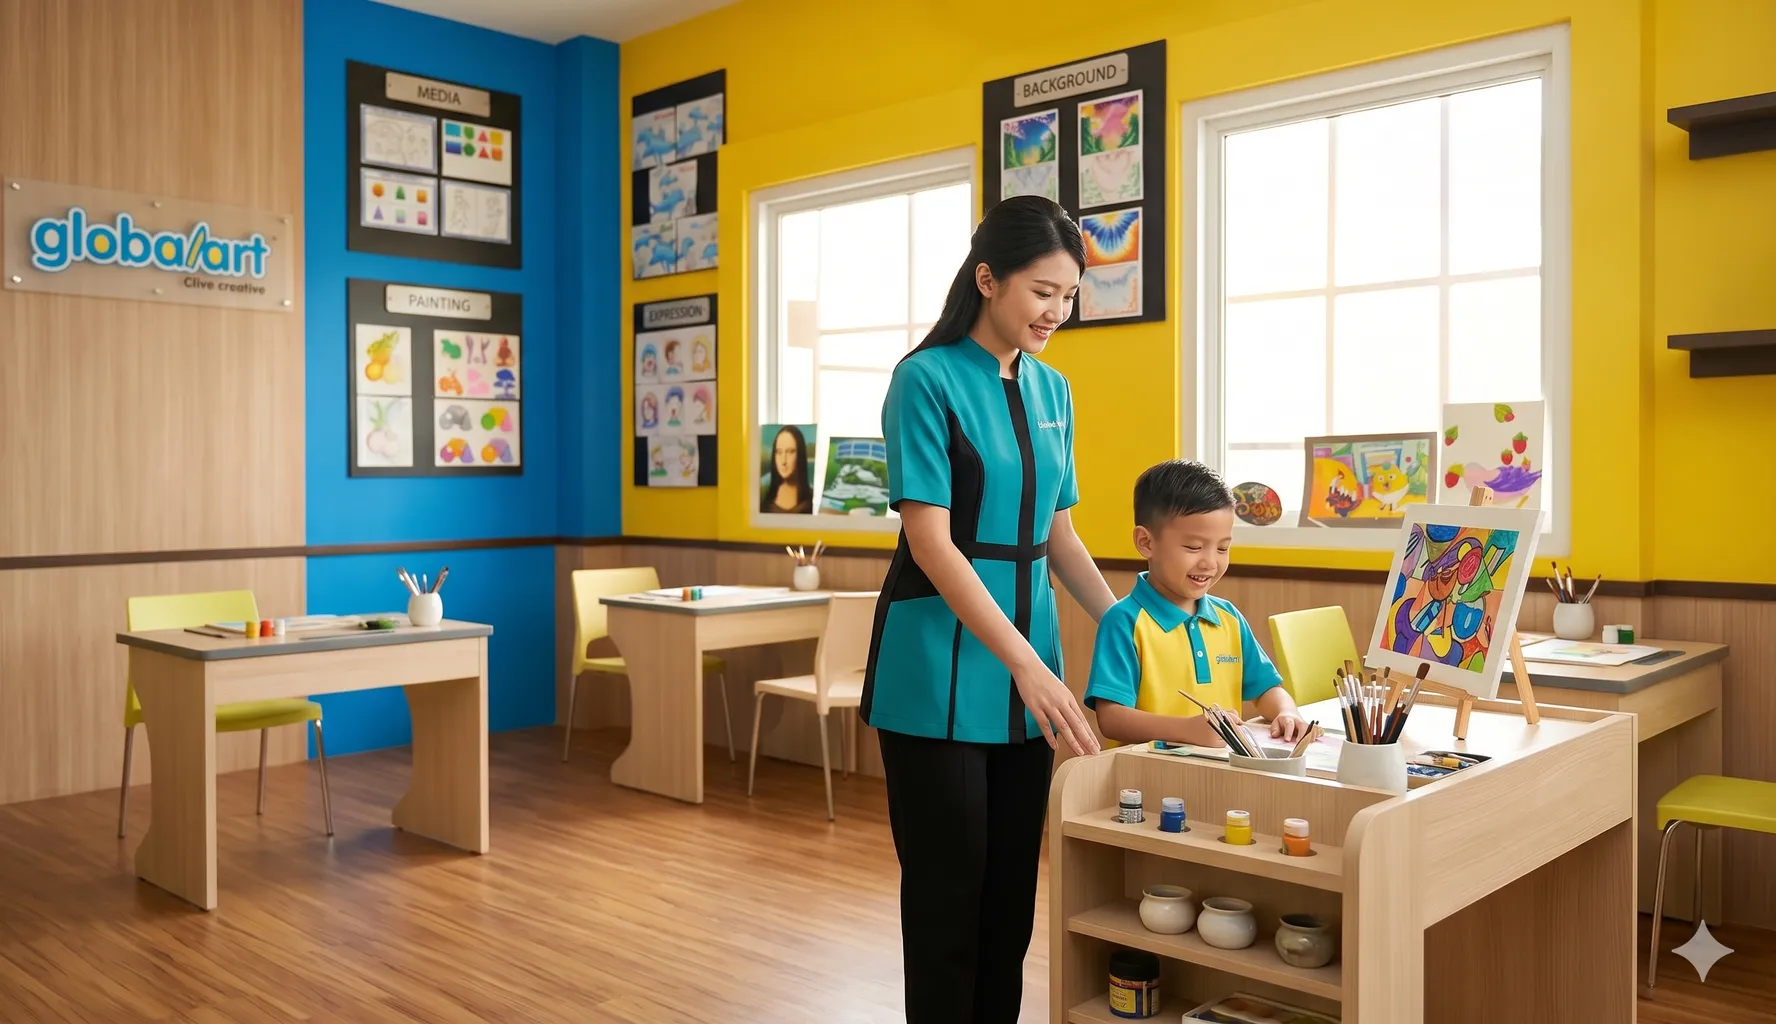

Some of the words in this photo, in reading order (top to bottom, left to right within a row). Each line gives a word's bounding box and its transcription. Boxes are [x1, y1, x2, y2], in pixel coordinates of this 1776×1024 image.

[1023, 64, 1117, 98] BACKGROUND
[417, 85, 461, 105] MEDIA
[184, 276, 214, 290] Clive
[218, 281, 265, 295] creative
[409, 294, 471, 312] PAINTING
